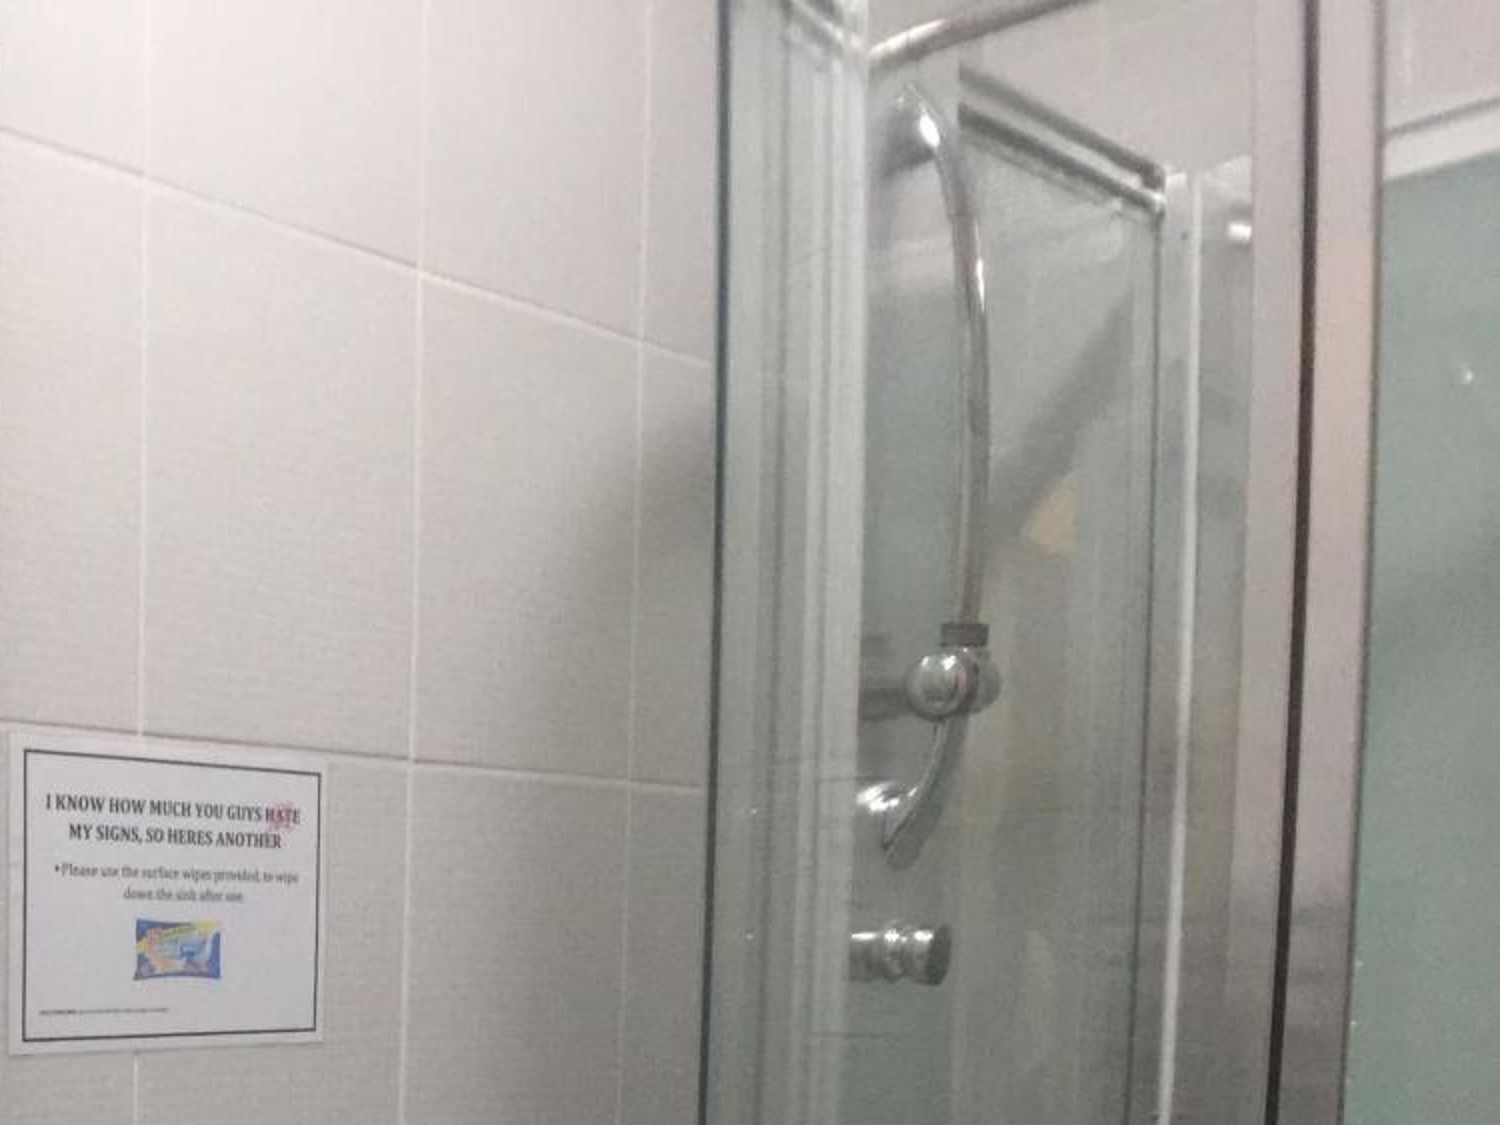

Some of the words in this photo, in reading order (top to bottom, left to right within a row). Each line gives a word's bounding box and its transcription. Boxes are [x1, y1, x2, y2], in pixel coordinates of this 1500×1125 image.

[45, 793, 51, 811] I
[55, 793, 105, 814] KNOW
[109, 797, 146, 816] HOW
[150, 799, 191, 819] MUCH
[195, 802, 223, 821] YOU
[227, 804, 262, 823] GUYS
[265, 807, 301, 826] HATE
[69, 823, 92, 841] MY
[96, 824, 142, 846] SIGNS,
[146, 827, 164, 844] SO
[167, 828, 213, 848] HERES
[216, 831, 282, 850] ANOTHER
[101, 866, 119, 878] use
[122, 864, 139, 878] the
[142, 864, 179, 880] surface
[182, 867, 212, 884] wipes
[124, 885, 152, 900] down
[156, 887, 173, 901] the
[176, 887, 196, 902] sink
[199, 888, 222, 902] after
